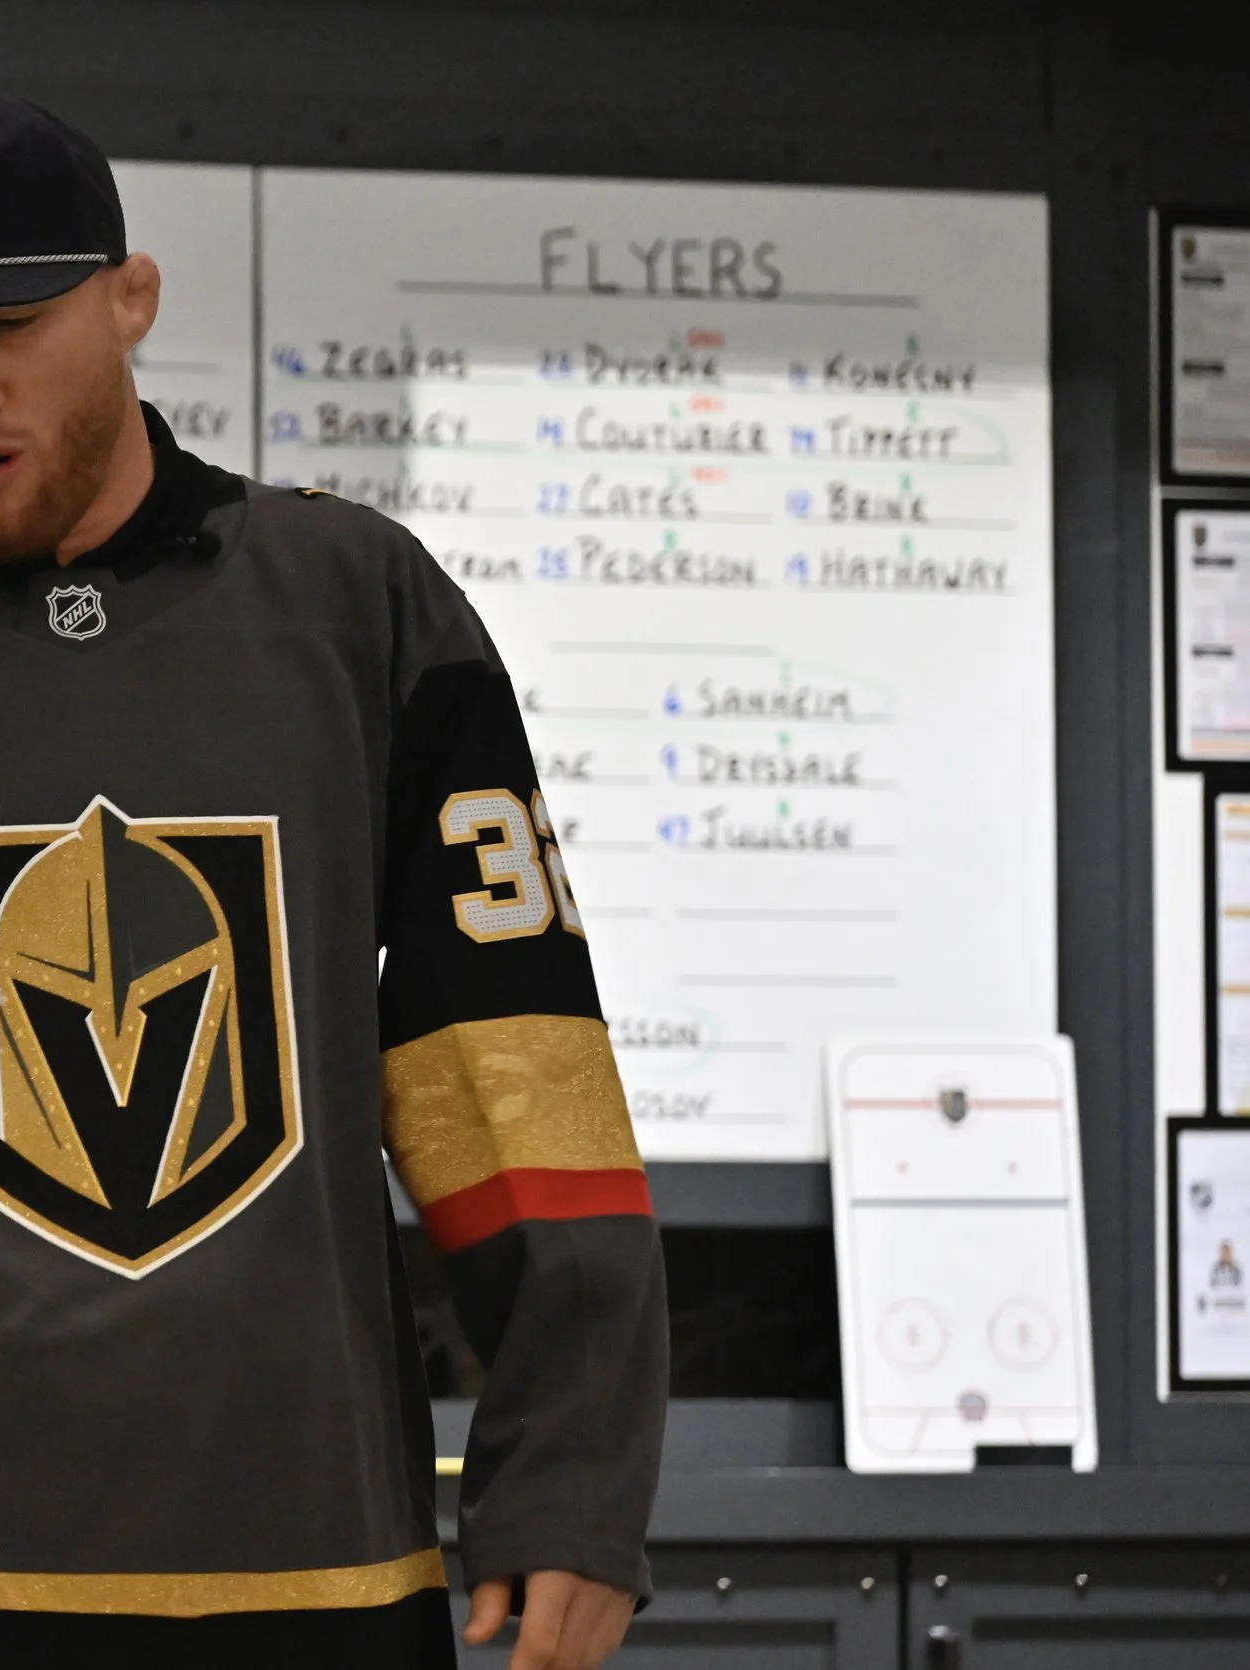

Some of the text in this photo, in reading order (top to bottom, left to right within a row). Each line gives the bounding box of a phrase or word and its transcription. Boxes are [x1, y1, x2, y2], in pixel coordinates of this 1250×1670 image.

[539, 226, 781, 299] FLYERS
[825, 414, 958, 459] TIPPETT
[579, 471, 699, 521] CATES
[821, 548, 1007, 589] HATHAWAY
[62, 600, 92, 629] NHL
[697, 678, 854, 721] SANHEIM
[702, 806, 853, 850] JUULSEN
[608, 1018, 702, 1049] SSON
